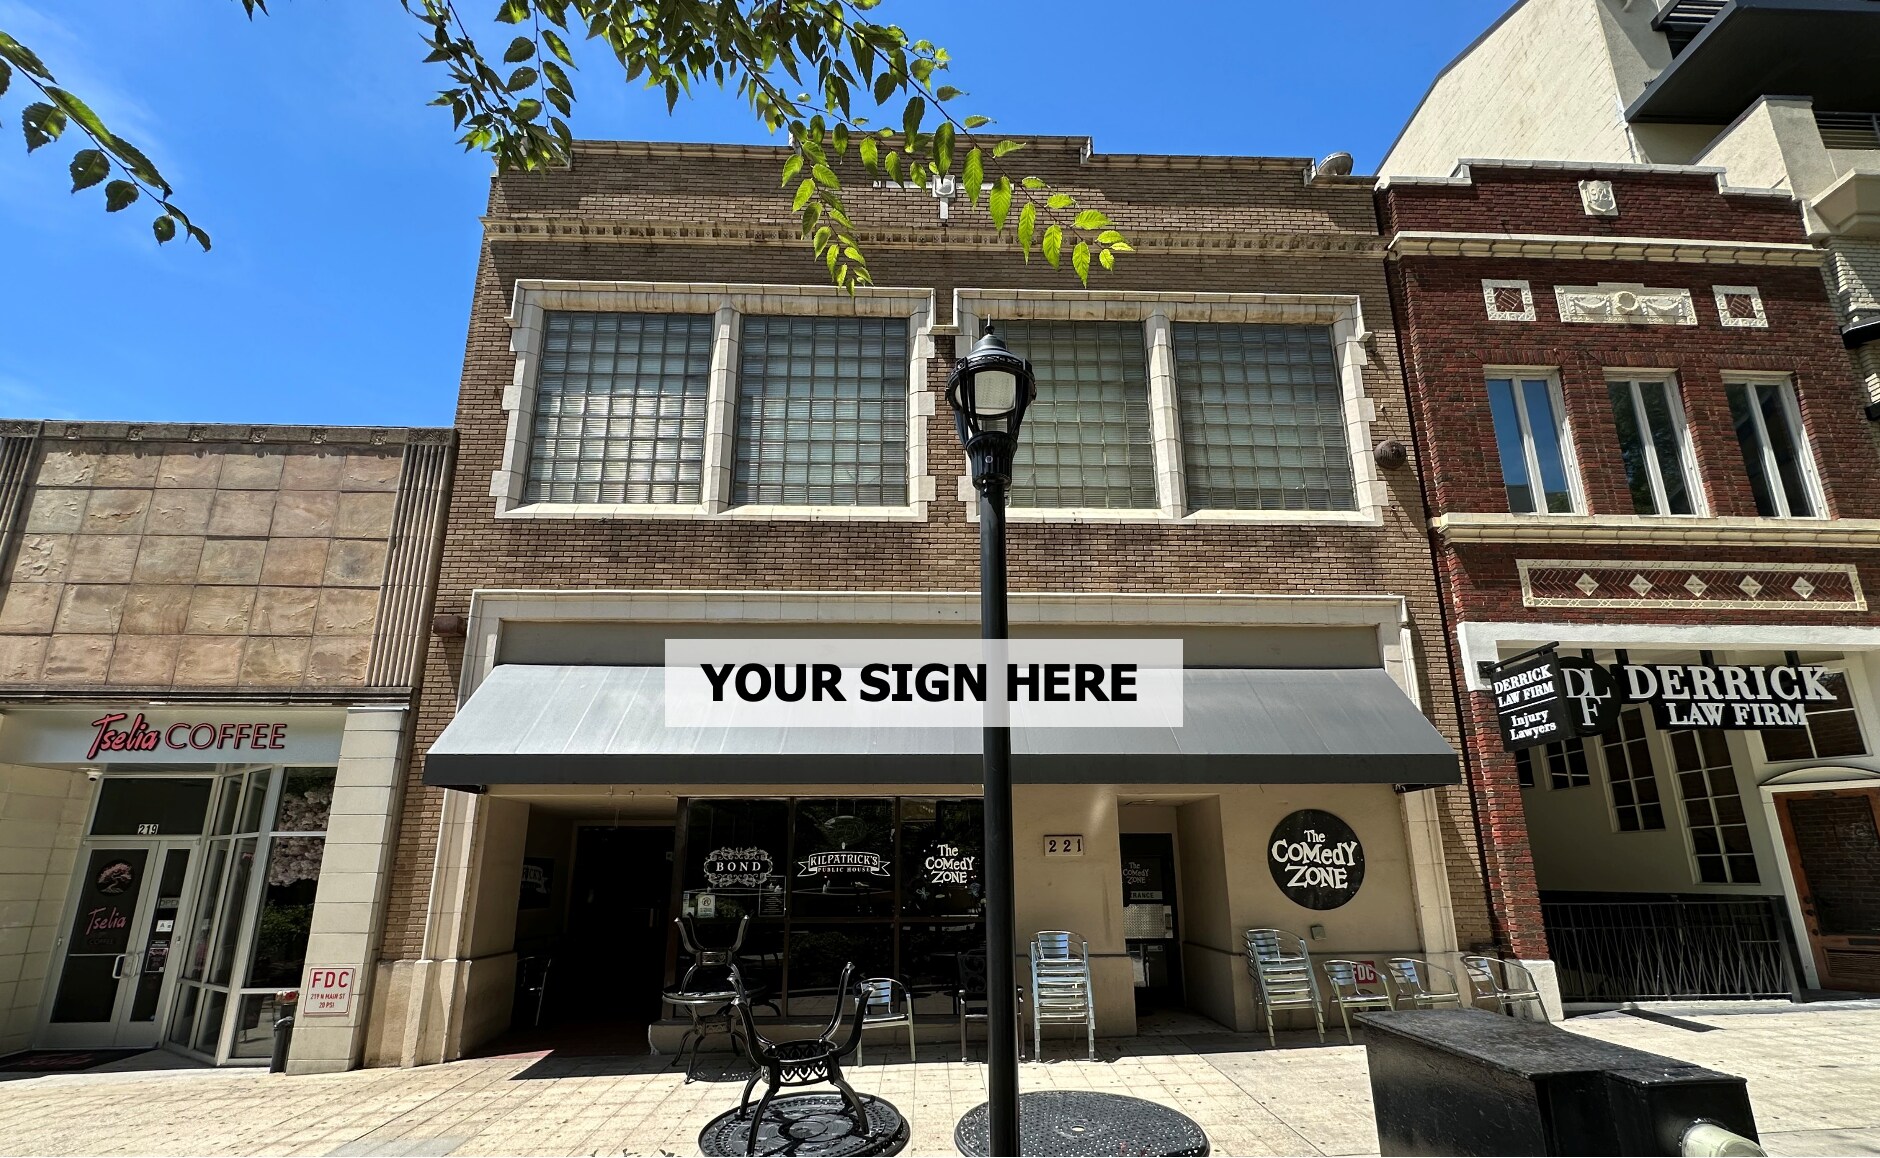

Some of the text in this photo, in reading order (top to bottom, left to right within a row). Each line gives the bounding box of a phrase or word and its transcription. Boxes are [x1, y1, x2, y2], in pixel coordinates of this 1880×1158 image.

[1494, 664, 1553, 695] DERRICK
[1623, 665, 1838, 700] DERRICK
[1497, 681, 1555, 708] LAW FIRM
[1510, 710, 1549, 728] Injury
[1666, 702, 1809, 726] LAW FIRM
[86, 713, 288, 760] Tselia COFFEE
[1509, 722, 1557, 741] Lawyers
[138, 824, 158, 835] 219
[1303, 829, 1326, 842] The
[936, 843, 959, 857] The
[715, 861, 761, 872] BOND
[810, 854, 878, 867] KILPATRICK'S
[1128, 861, 1141, 869] The
[930, 869, 968, 884] ZONE
[1126, 875, 1146, 884] ZONE
[1284, 862, 1348, 889] ZONE
[85, 907, 127, 936] Tselia
[311, 971, 350, 989] FDC
